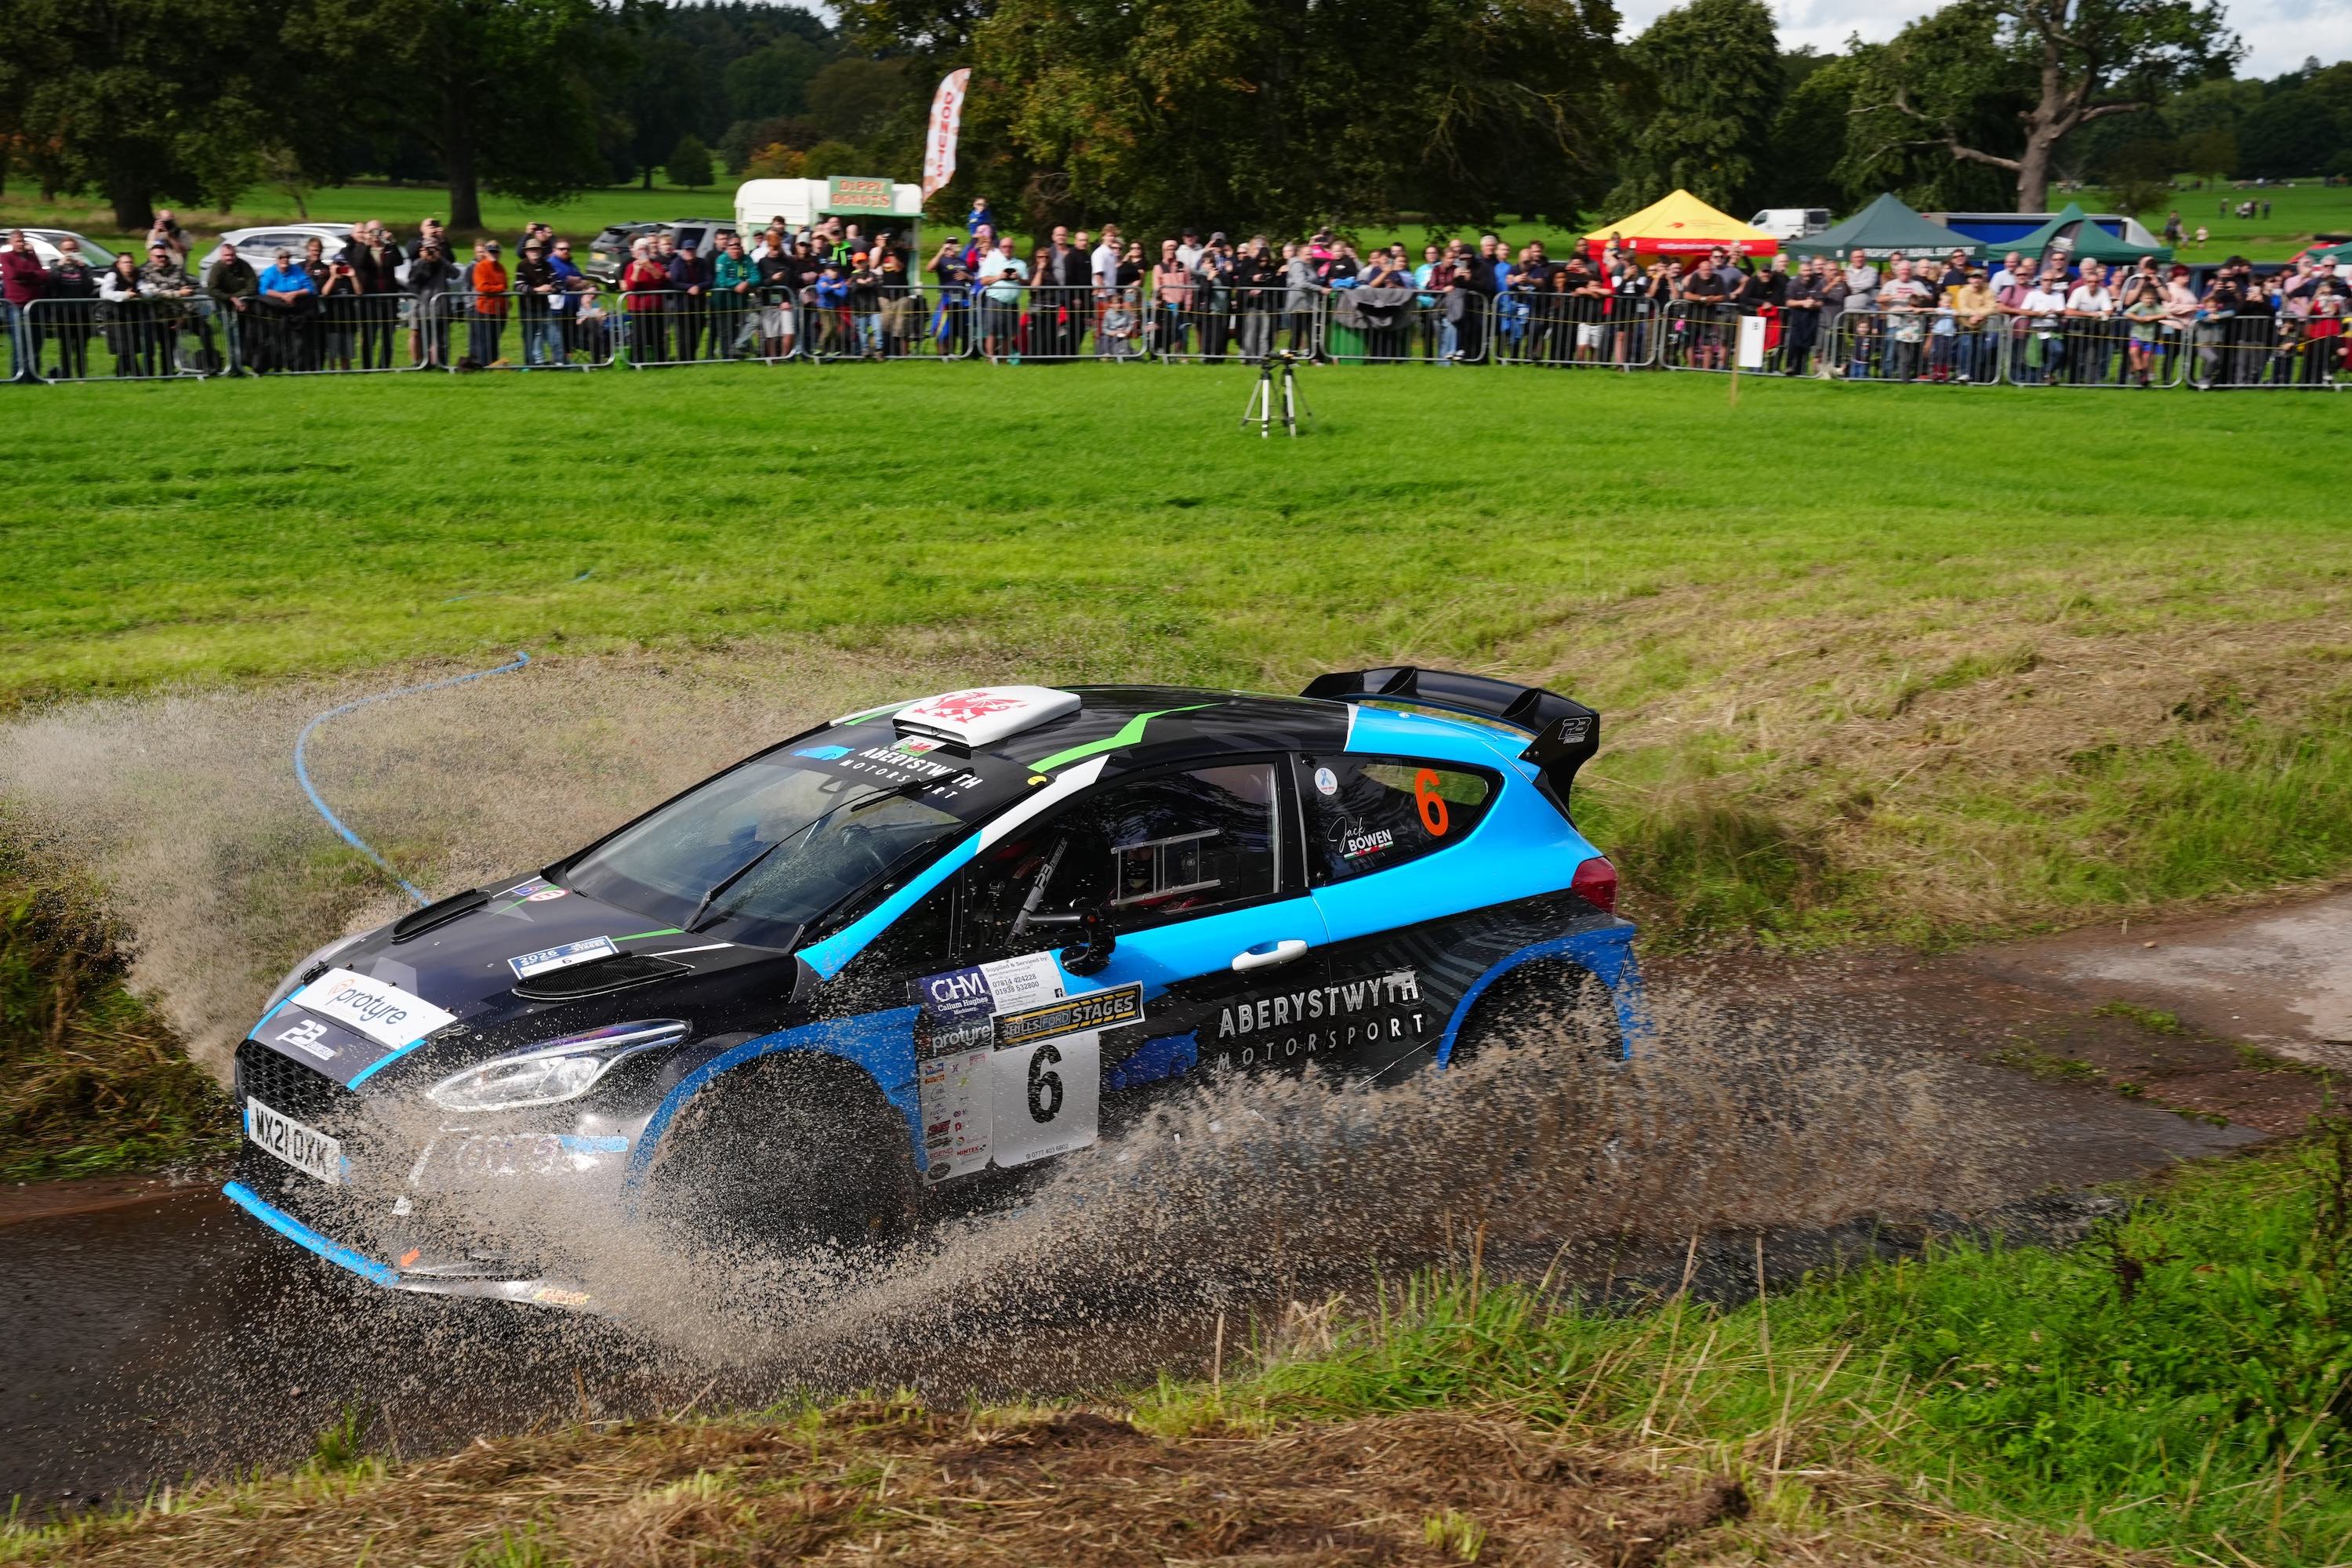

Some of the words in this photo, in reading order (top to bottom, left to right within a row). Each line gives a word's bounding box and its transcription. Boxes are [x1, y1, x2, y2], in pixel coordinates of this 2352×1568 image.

[936, 91, 954, 177] DONUTS
[839, 179, 885, 193] DIPPY
[830, 193, 891, 209] DONUTS
[1414, 768, 1449, 837] 6
[1327, 816, 1366, 854] Jack
[1348, 829, 1392, 852] BOWEN
[518, 949, 558, 964] 2026
[931, 971, 986, 1003] CHM
[993, 978, 1013, 988] 07814
[995, 985, 1015, 996] 01938
[1015, 981, 1040, 992] 532800
[326, 986, 408, 1025] protyre
[938, 1000, 963, 1012] Callum
[963, 995, 989, 1008] Hughes
[1043, 1013, 1069, 1029] FORD
[1071, 995, 1135, 1023] STAGES
[1218, 970, 1420, 1039] ABERYSTWYTH
[931, 1024, 992, 1055] protyre
[1218, 1014, 1423, 1071] MOTORSPORT
[1028, 1044, 1063, 1123] 6
[928, 1147, 953, 1160] EGEND
[956, 1146, 979, 1156] MINTEX
[1045, 1146, 1055, 1155] 403
